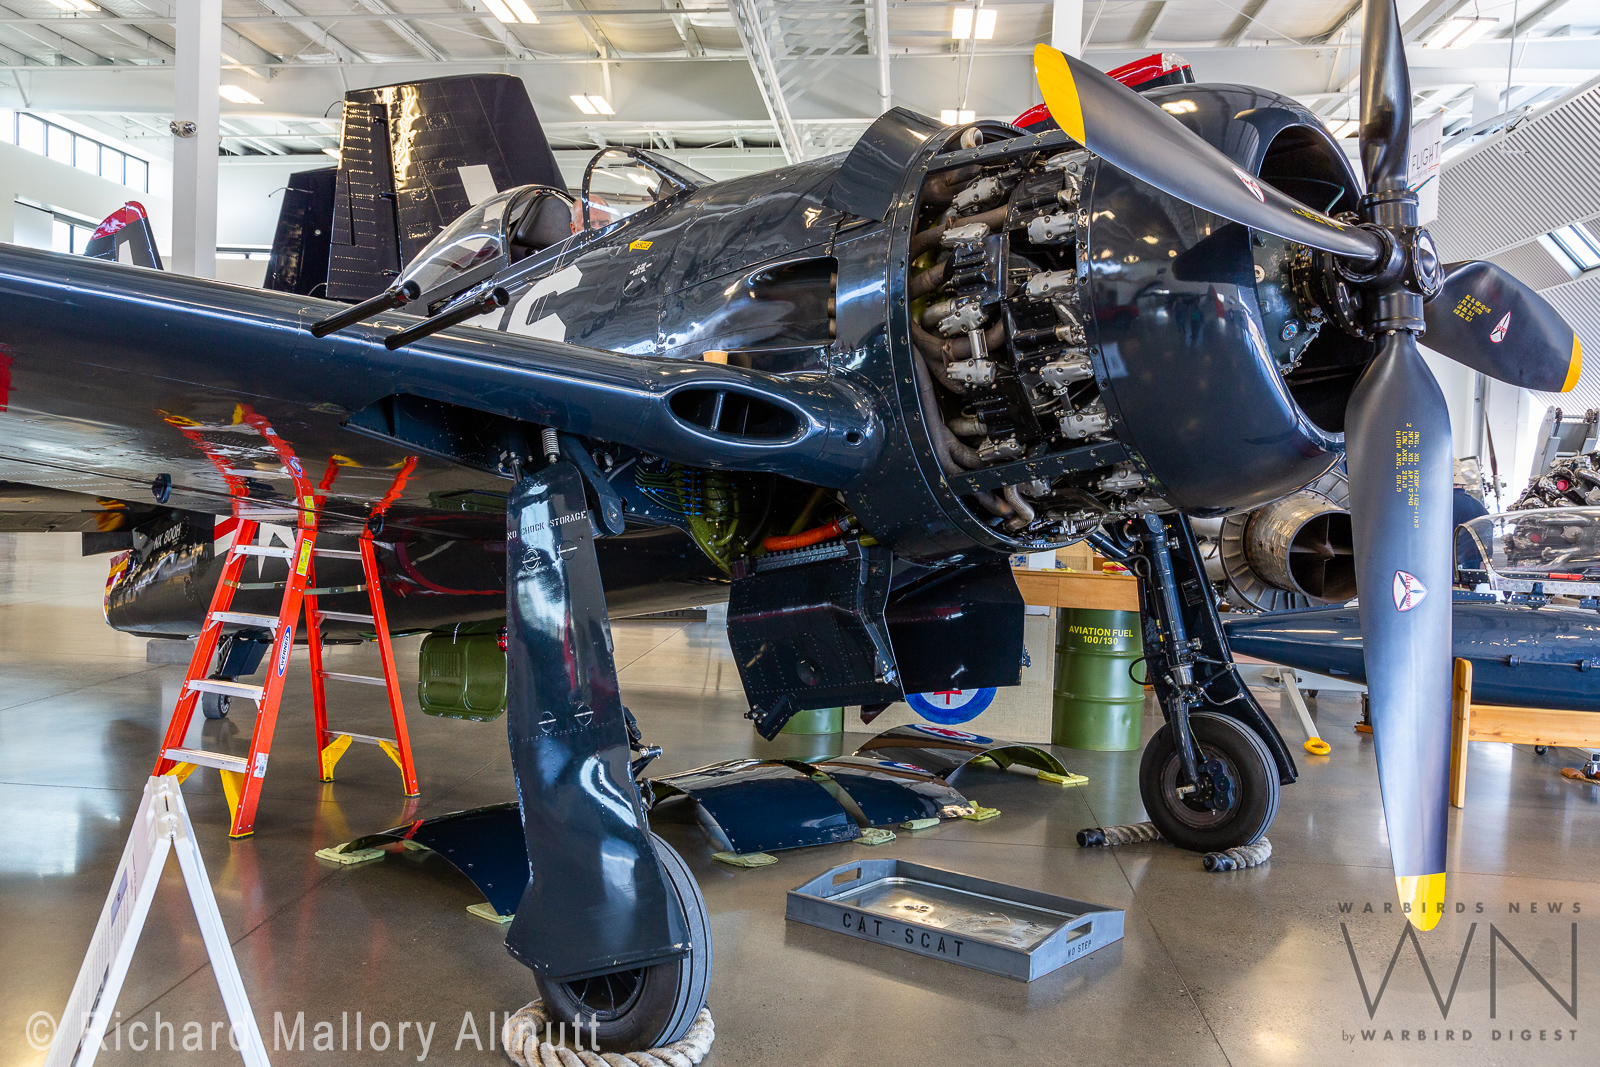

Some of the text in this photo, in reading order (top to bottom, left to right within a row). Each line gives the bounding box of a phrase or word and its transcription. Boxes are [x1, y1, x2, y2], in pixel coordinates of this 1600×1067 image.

[1411, 140, 1440, 172] FLIGHT
[549, 510, 587, 527] STORAGE
[1068, 625, 1134, 638] AVIATION FUEL
[1083, 635, 1119, 645] 100/130
[280, 635, 289, 666] WERNER
[1067, 939, 1092, 958] NO STEP
